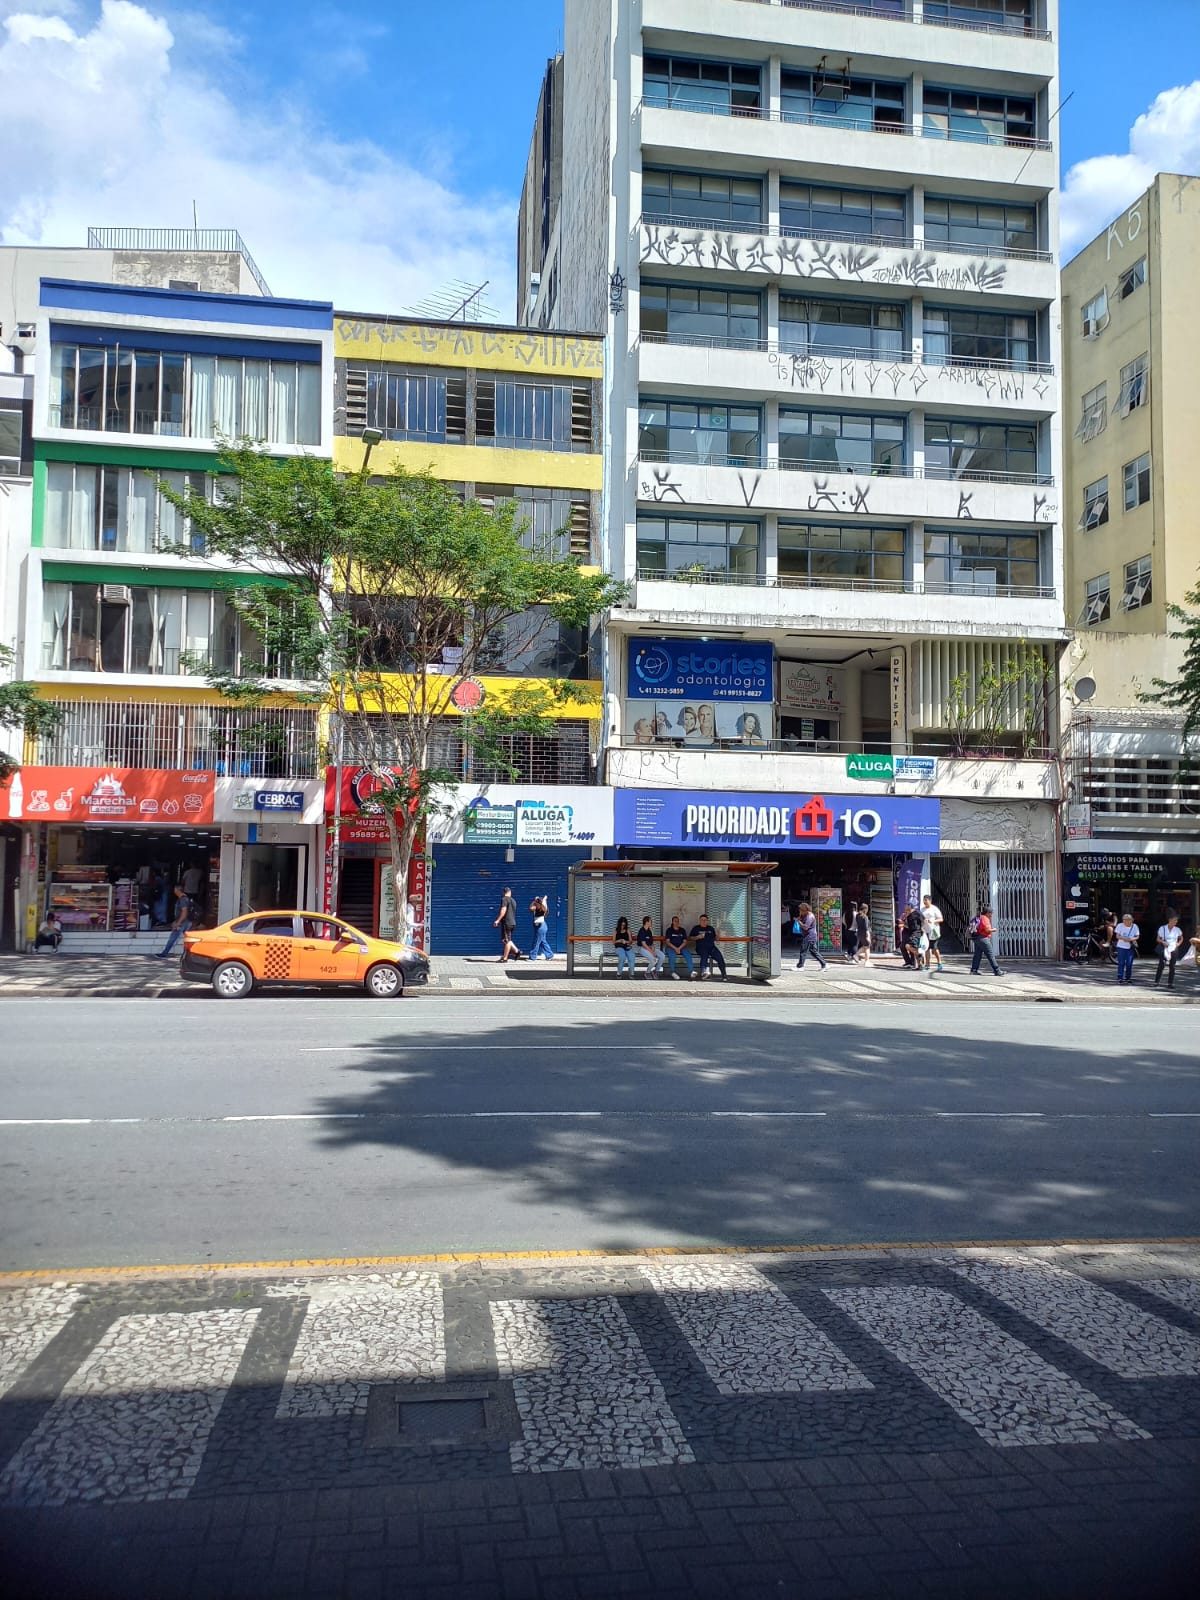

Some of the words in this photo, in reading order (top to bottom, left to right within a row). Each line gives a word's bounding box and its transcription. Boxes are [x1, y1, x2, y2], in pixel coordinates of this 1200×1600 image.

[677, 652, 767, 675] stories
[676, 674, 766, 688] odontologia
[848, 761, 892, 771] ALUGA
[80, 795, 137, 806] Marechal
[257, 793, 302, 805] CEBRAC
[521, 810, 566, 822] ALUGA
[686, 804, 790, 836] PRIORIDADE
[840, 808, 881, 838] 10
[1077, 855, 1127, 863] ACESSÓRIOS
[1077, 863, 1122, 871] CELULARES
[1131, 864, 1163, 872] TABLETS
